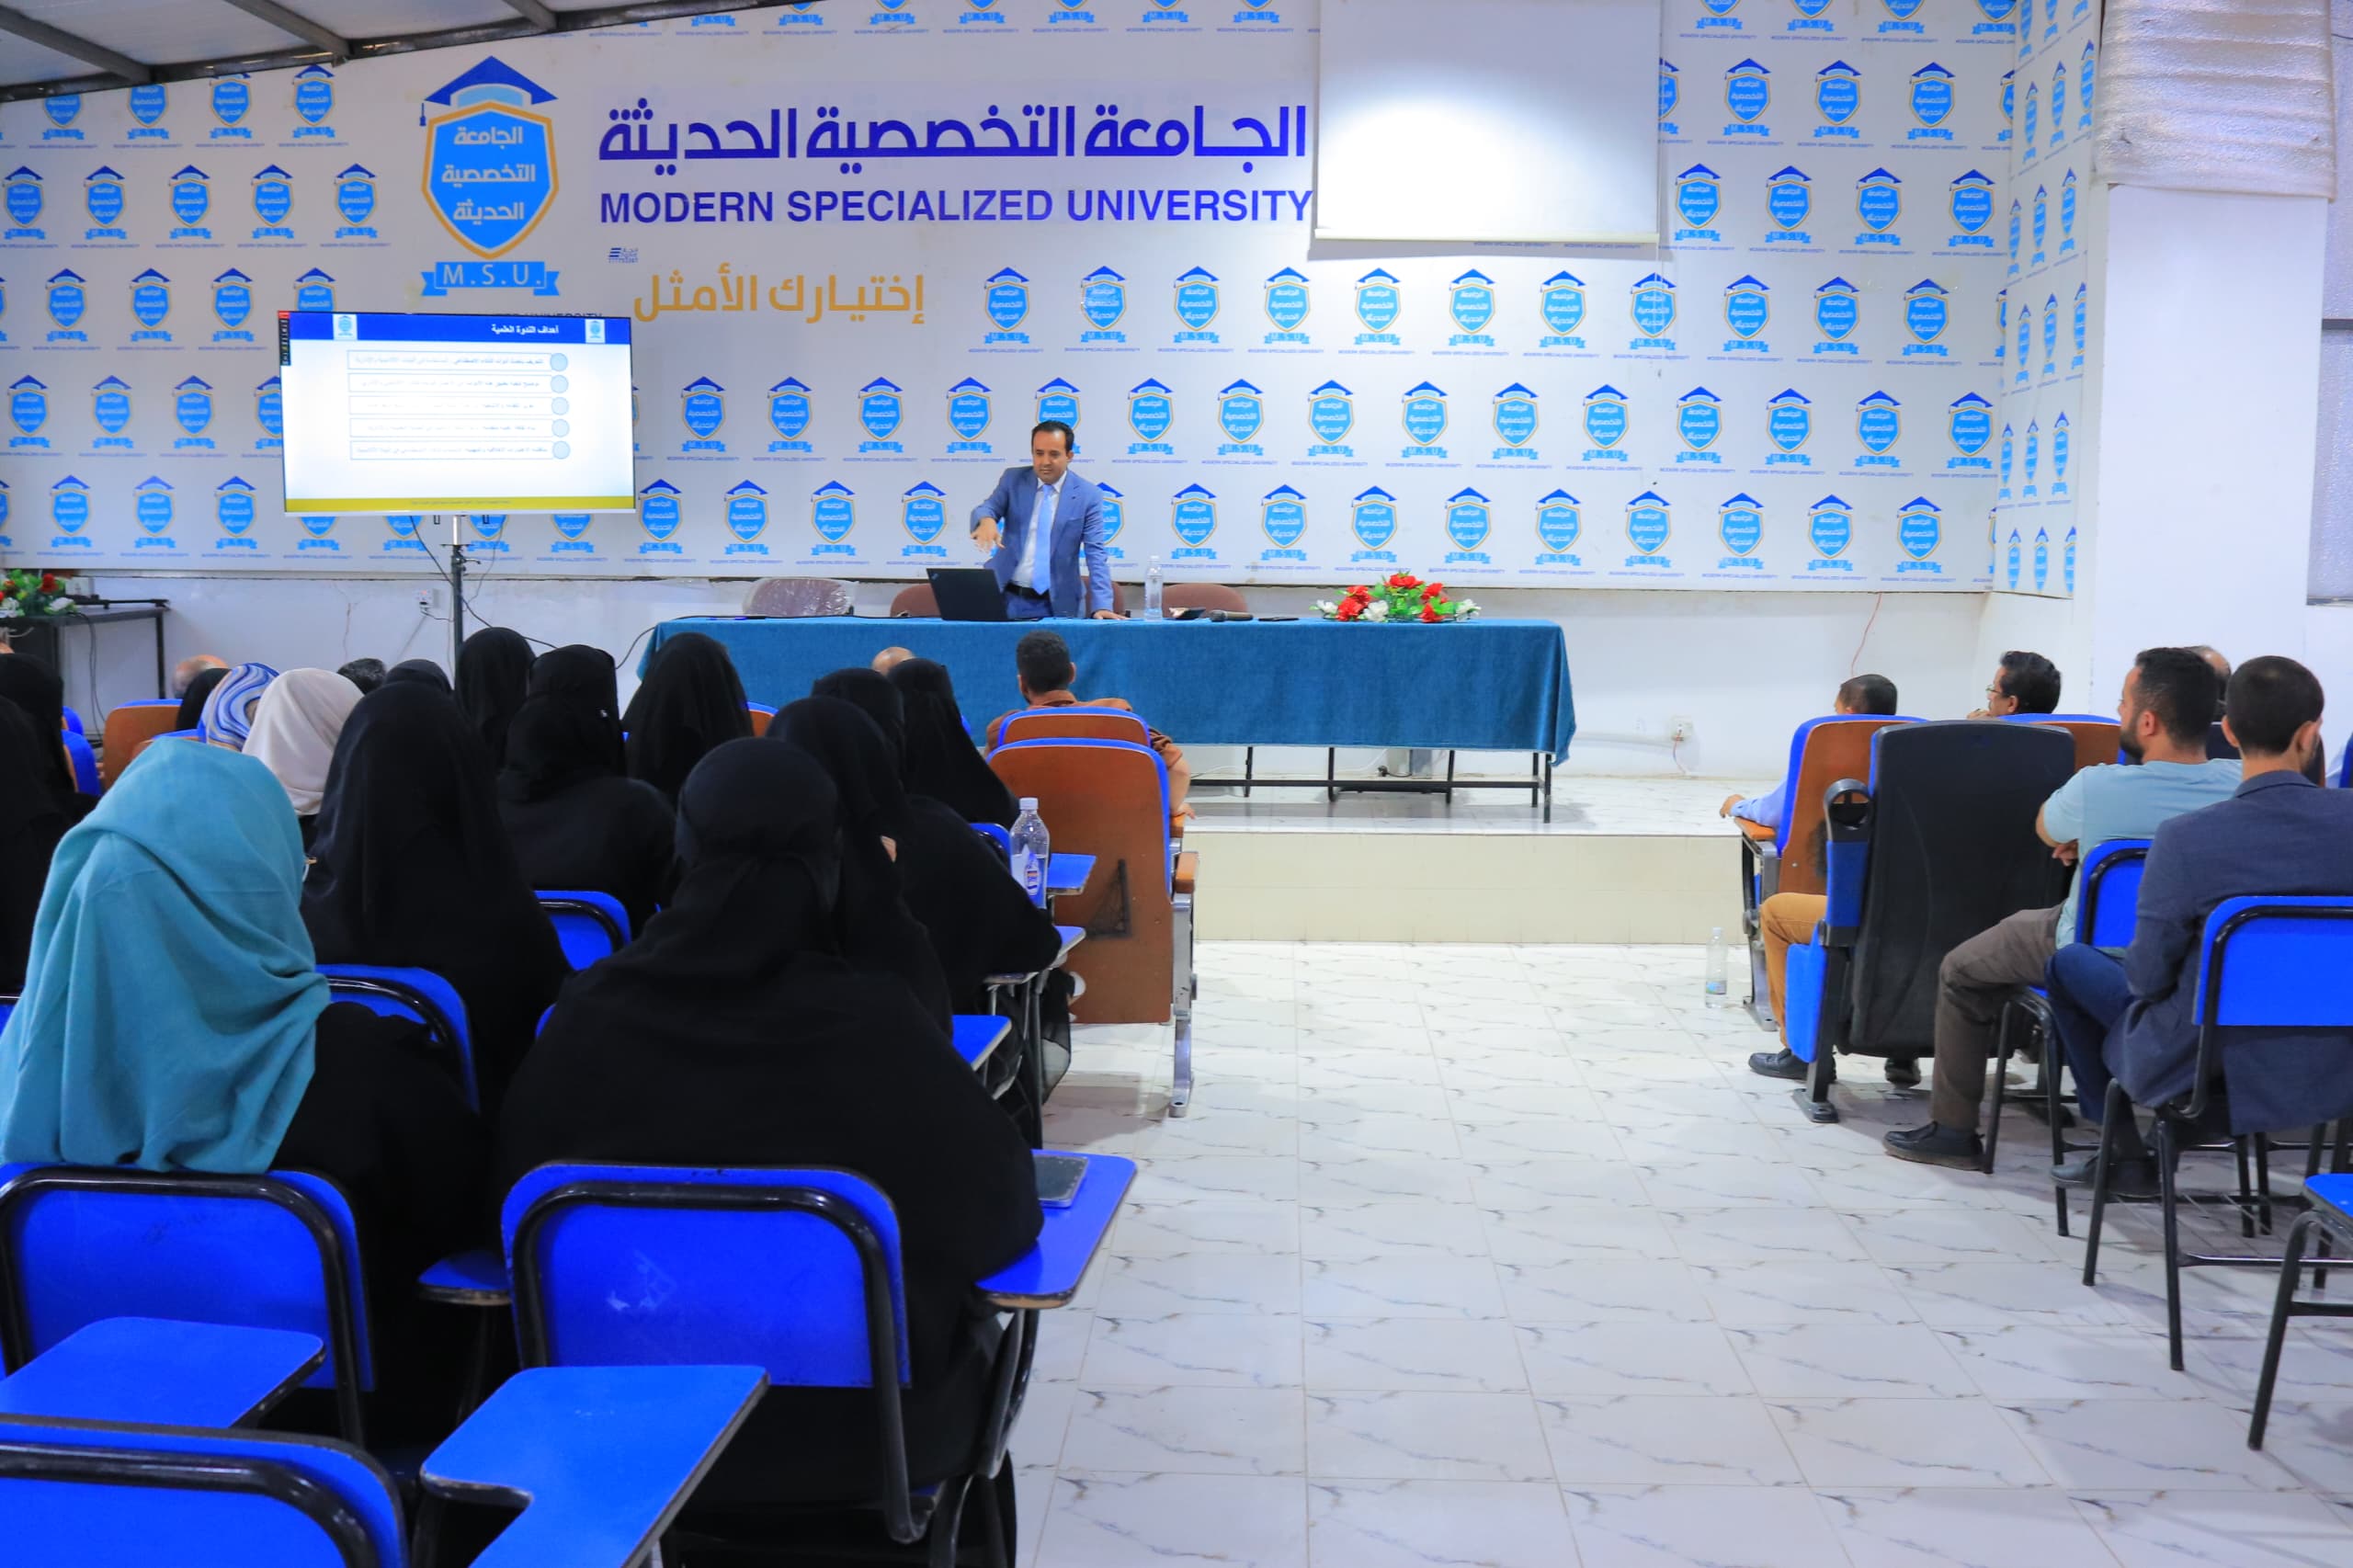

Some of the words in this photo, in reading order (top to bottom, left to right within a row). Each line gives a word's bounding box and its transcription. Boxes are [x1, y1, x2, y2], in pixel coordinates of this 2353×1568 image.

[453, 126, 524, 150] الجامعة
[599, 97, 799, 176] الحديثة
[806, 106, 1076, 175] التخصصية
[1086, 106, 1308, 175] الجامعة
[441, 164, 537, 188] التخصصية
[452, 199, 525, 225] الحديثة
[601, 192, 774, 224] MODERN
[789, 190, 1053, 223] SPECIALIZED
[1069, 189, 1314, 222] UNIVERSITY
[635, 264, 759, 324] الأمثل
[770, 276, 925, 325] إختيارك
